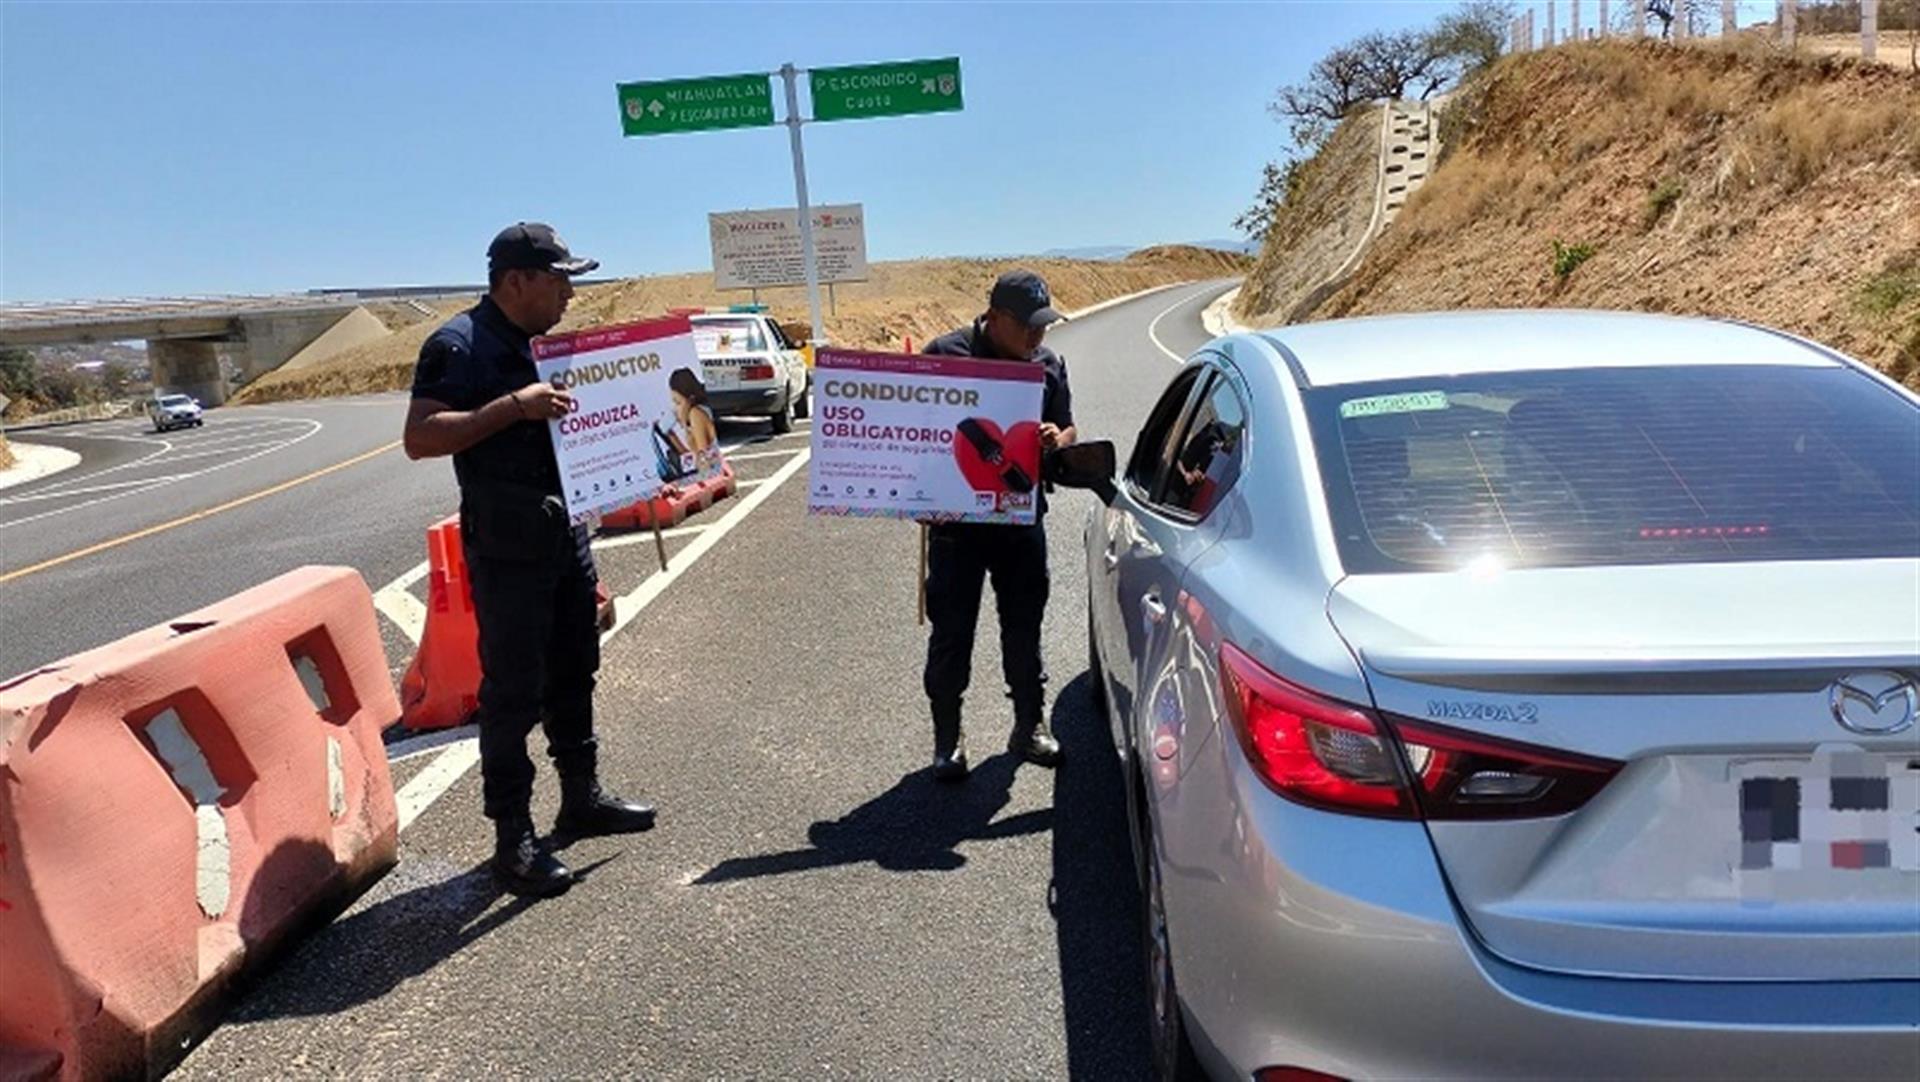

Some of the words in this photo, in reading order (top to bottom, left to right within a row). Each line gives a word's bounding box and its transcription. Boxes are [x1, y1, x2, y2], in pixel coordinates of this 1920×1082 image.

[666, 83, 766, 102] MIAHUATLAN
[815, 77, 826, 91] P
[829, 72, 917, 91] ESCONDIDO
[550, 353, 661, 388] CONDUCTOR
[824, 380, 979, 407] CONDUCTOR
[559, 403, 638, 435] CONDUZCA
[823, 405, 865, 421] USO
[821, 422, 953, 444] OBLIGATORIO
